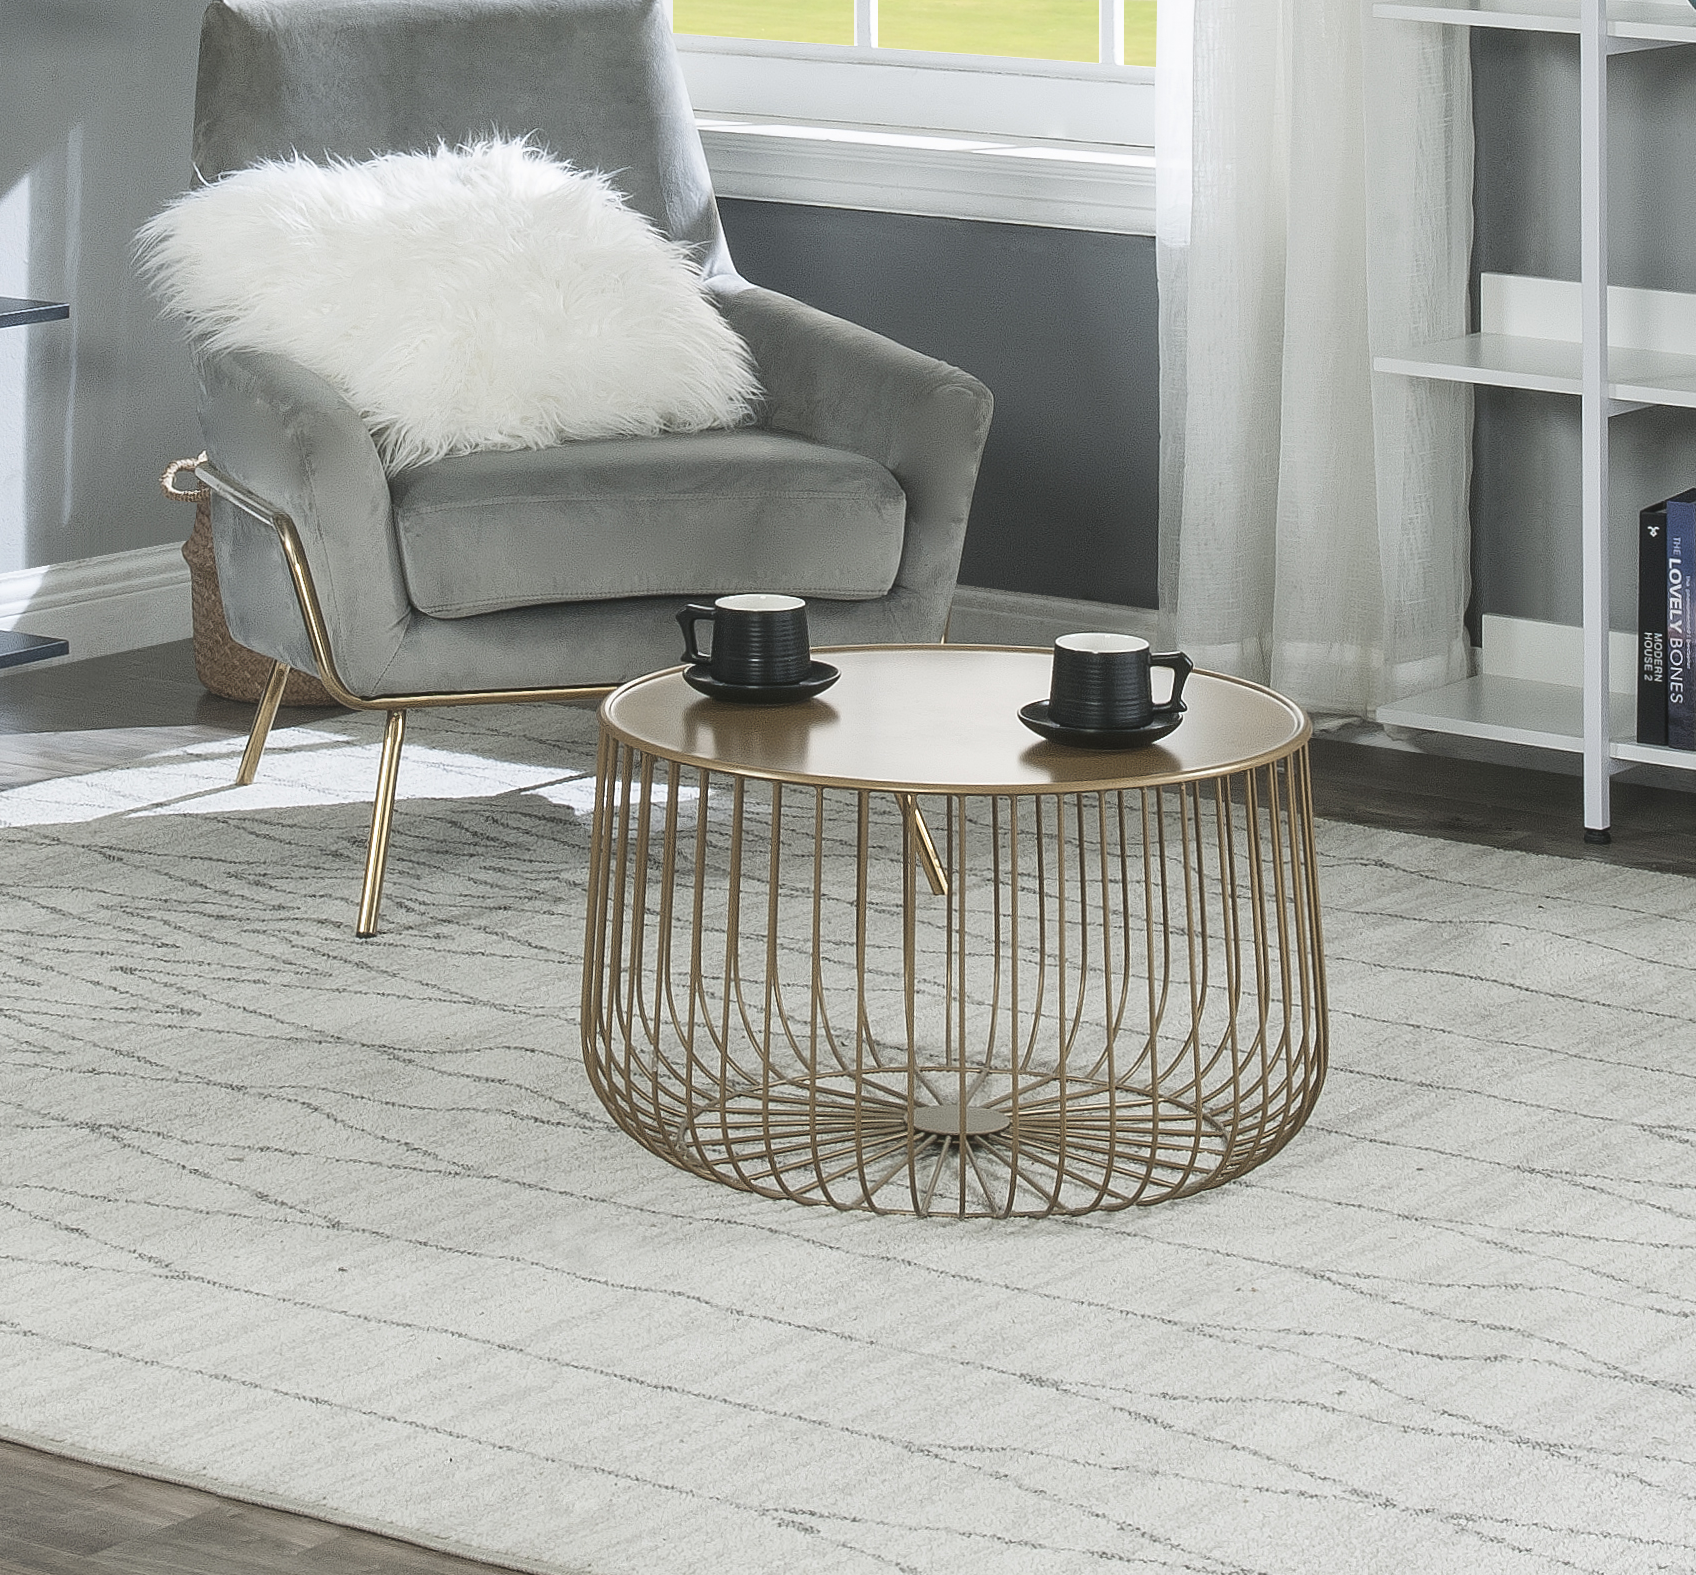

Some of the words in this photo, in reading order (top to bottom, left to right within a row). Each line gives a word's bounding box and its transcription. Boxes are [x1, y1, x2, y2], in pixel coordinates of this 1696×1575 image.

[1672, 537, 1681, 556] THE
[1669, 557, 1683, 634] LOVELY
[1643, 632, 1653, 671] HOUSE
[1653, 632, 1663, 683] MODERN
[1670, 637, 1684, 704] BONES
[1643, 674, 1653, 682] 2
